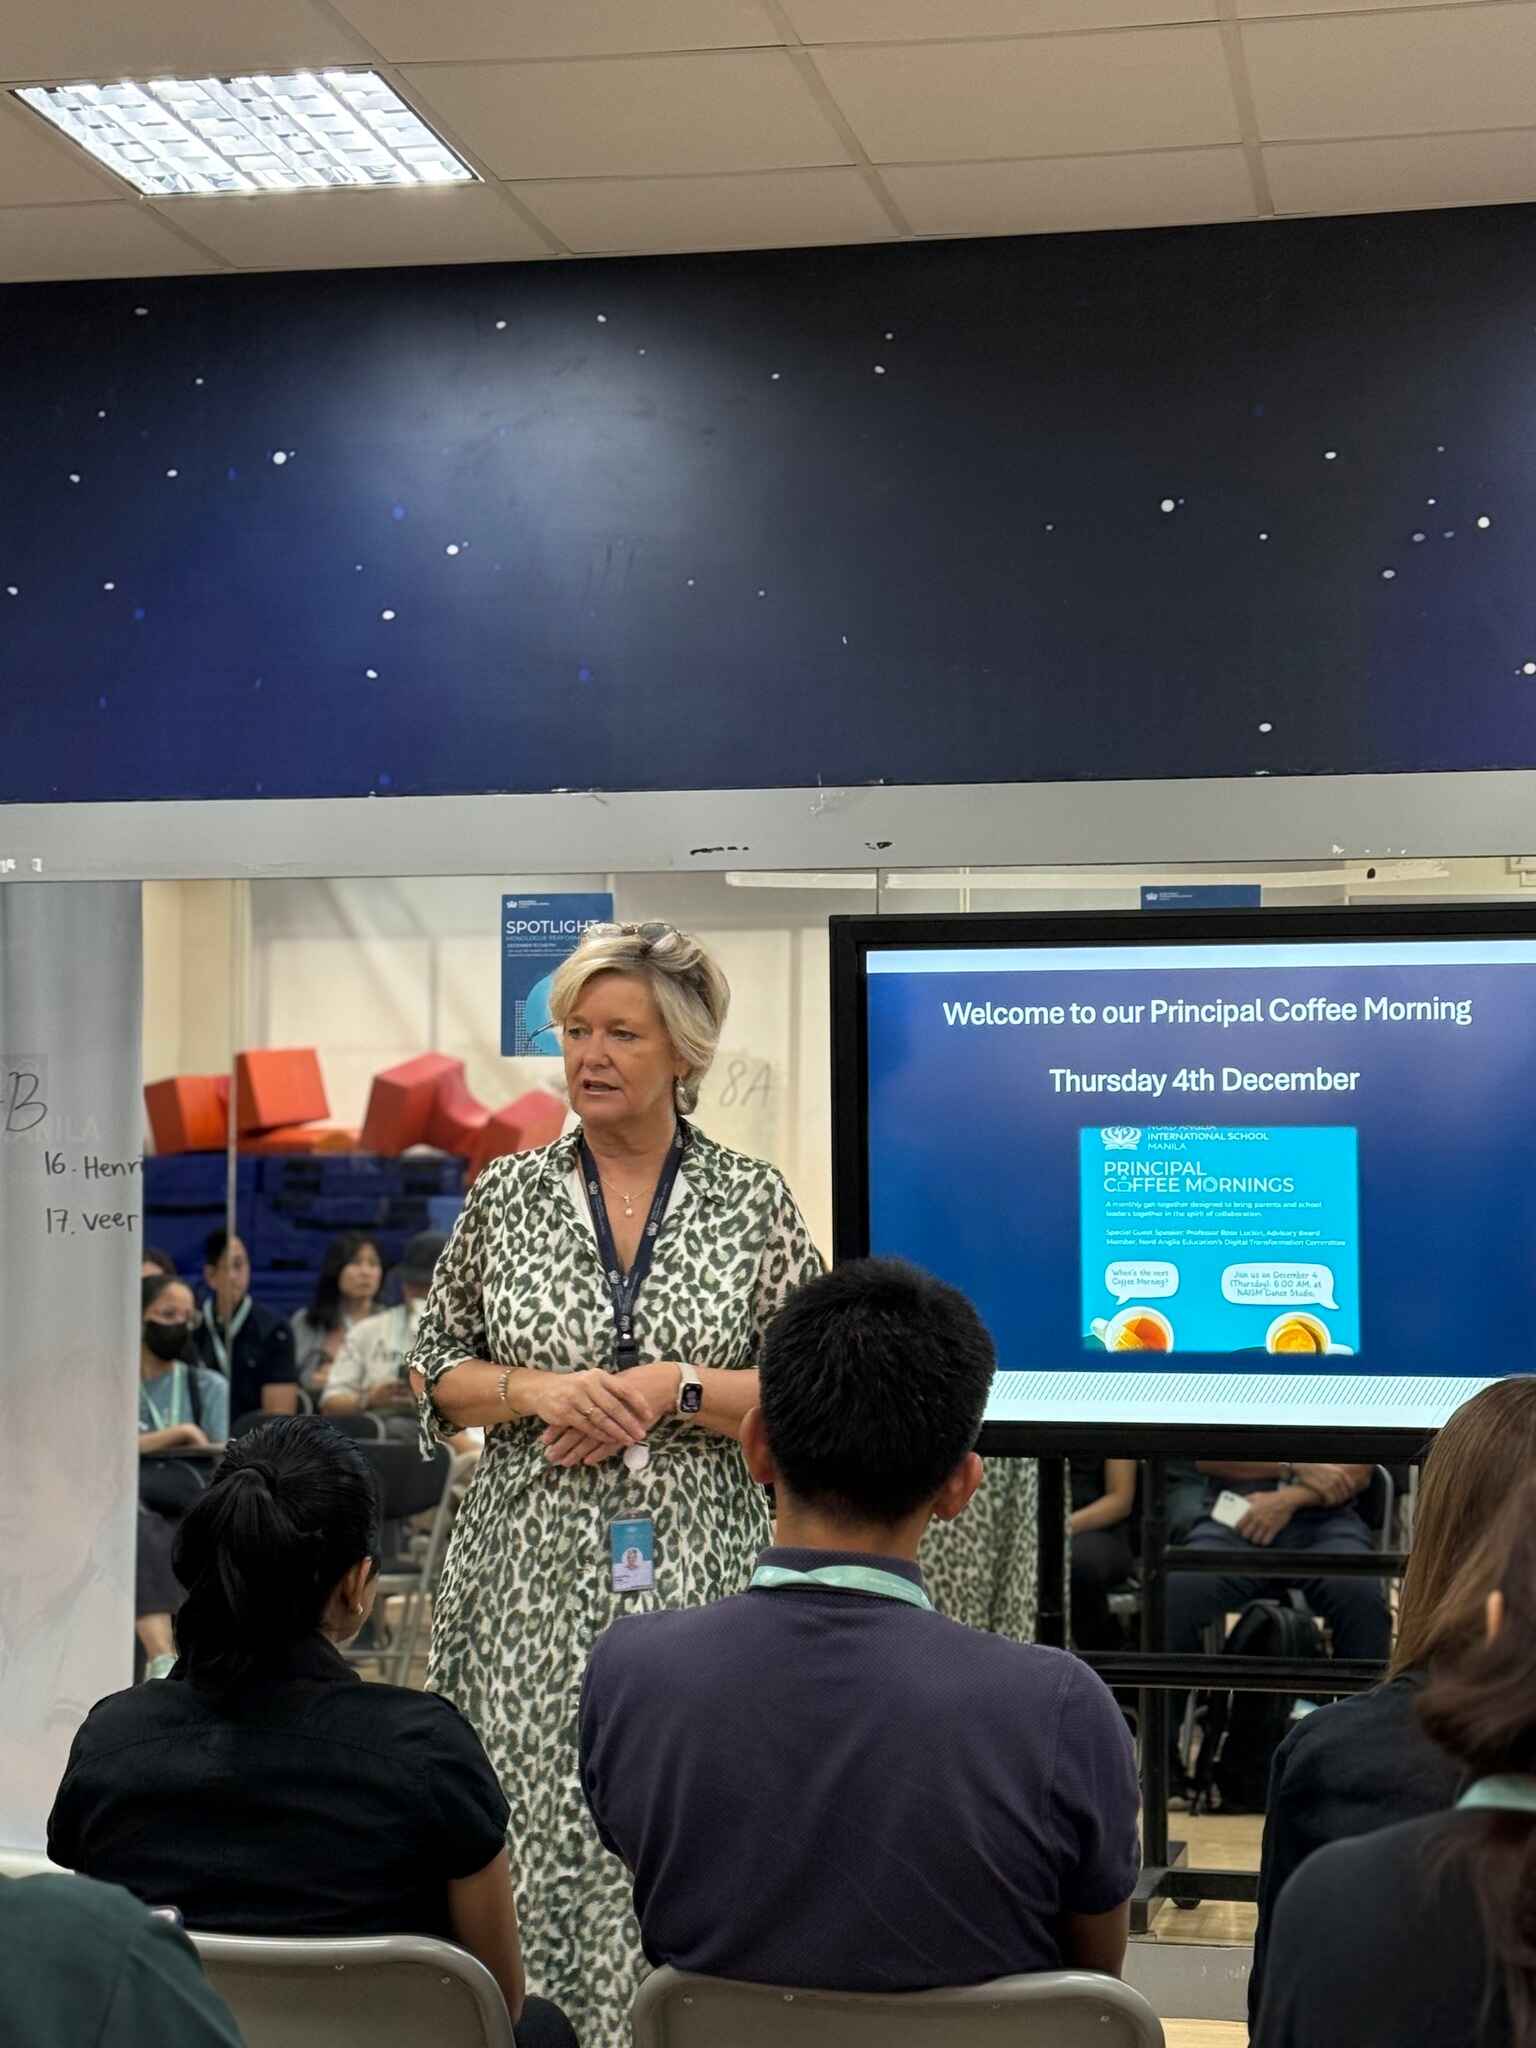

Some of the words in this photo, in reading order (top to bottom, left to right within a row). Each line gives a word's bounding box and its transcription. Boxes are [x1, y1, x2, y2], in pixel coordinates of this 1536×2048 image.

[943, 1001, 1065, 1026] Welcome
[1069, 1002, 1097, 1025] to
[1102, 1004, 1145, 1024] our
[1151, 999, 1264, 1028] Principal
[1269, 997, 1358, 1023] Coffee
[1364, 996, 1473, 1026] Morning
[719, 1059, 772, 1108] 8A
[1049, 1068, 1168, 1098] Thursday
[1172, 1068, 1215, 1093] 4th
[1222, 1067, 1361, 1092] December
[1147, 1132, 1226, 1141] INTERNATIONAL
[1227, 1132, 1269, 1141] SCHOOL
[1147, 1142, 1187, 1151] MANILA
[1104, 1161, 1207, 1176] PRINCIPAL
[1185, 1176, 1294, 1193] MORNINGS
